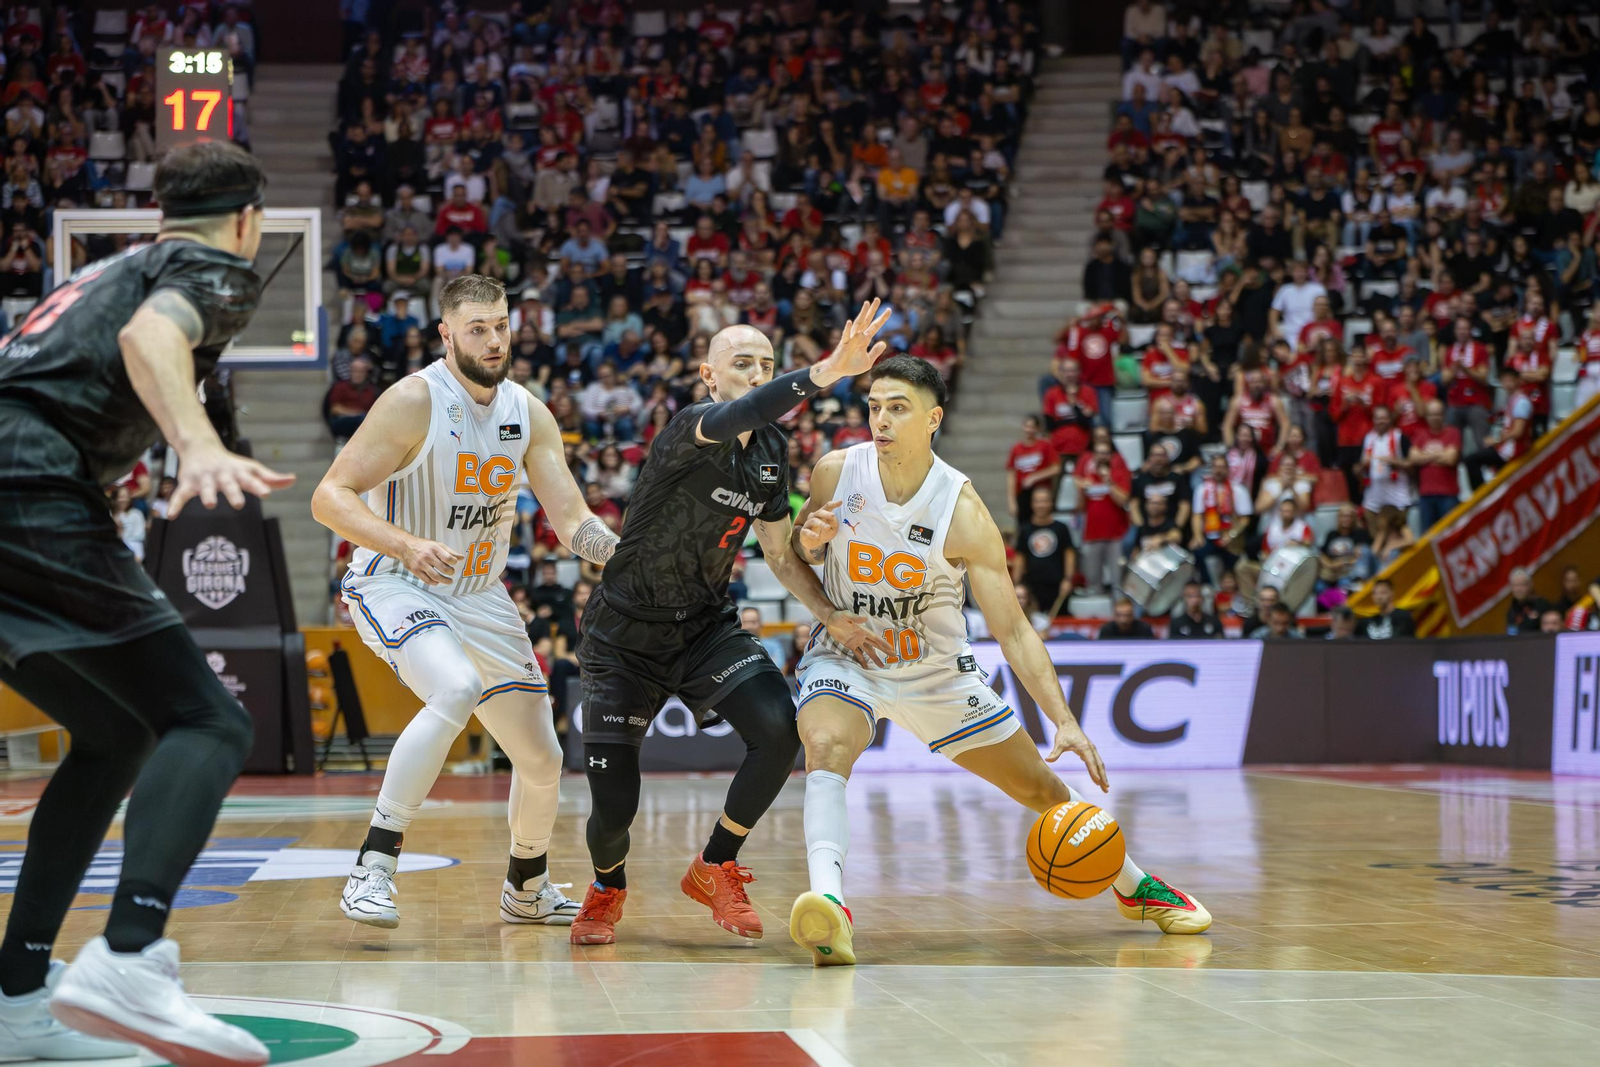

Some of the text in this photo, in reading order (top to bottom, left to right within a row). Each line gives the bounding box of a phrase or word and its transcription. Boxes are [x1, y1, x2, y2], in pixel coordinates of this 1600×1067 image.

[169, 51, 223, 74] 3:15
[164, 88, 222, 131] 17
[454, 451, 517, 498] BG
[718, 516, 747, 549] 2
[462, 540, 494, 578] 12
[847, 540, 928, 591] BG
[186, 575, 246, 593] GIRONA
[406, 609, 441, 624] YOSO
[853, 591, 935, 620] FIATC
[882, 627, 922, 664] 10
[721, 654, 766, 678] BERNER
[808, 679, 850, 692] YOSOY
[603, 714, 625, 724] vive
